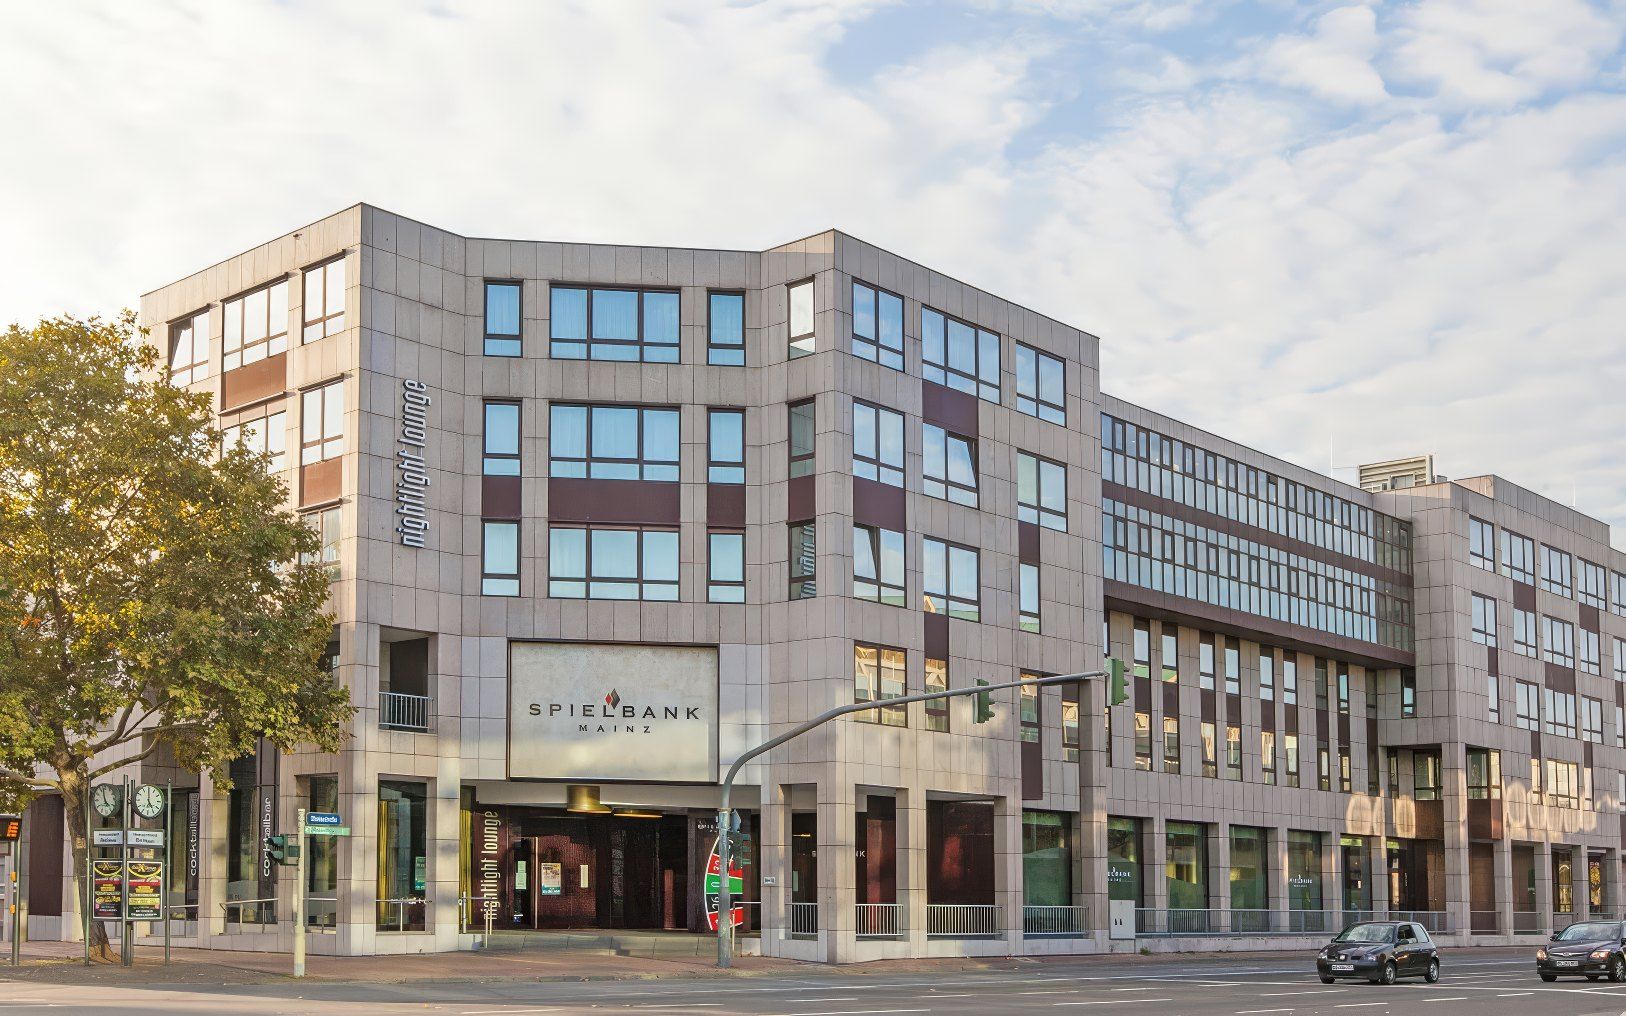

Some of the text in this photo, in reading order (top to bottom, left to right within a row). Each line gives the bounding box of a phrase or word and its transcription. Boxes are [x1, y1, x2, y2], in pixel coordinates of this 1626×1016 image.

[397, 379, 431, 548] nightlight lounge
[529, 703, 699, 720] SPIELBANK
[579, 724, 651, 734] MAINZ
[480, 811, 501, 920] nightlight lounge
